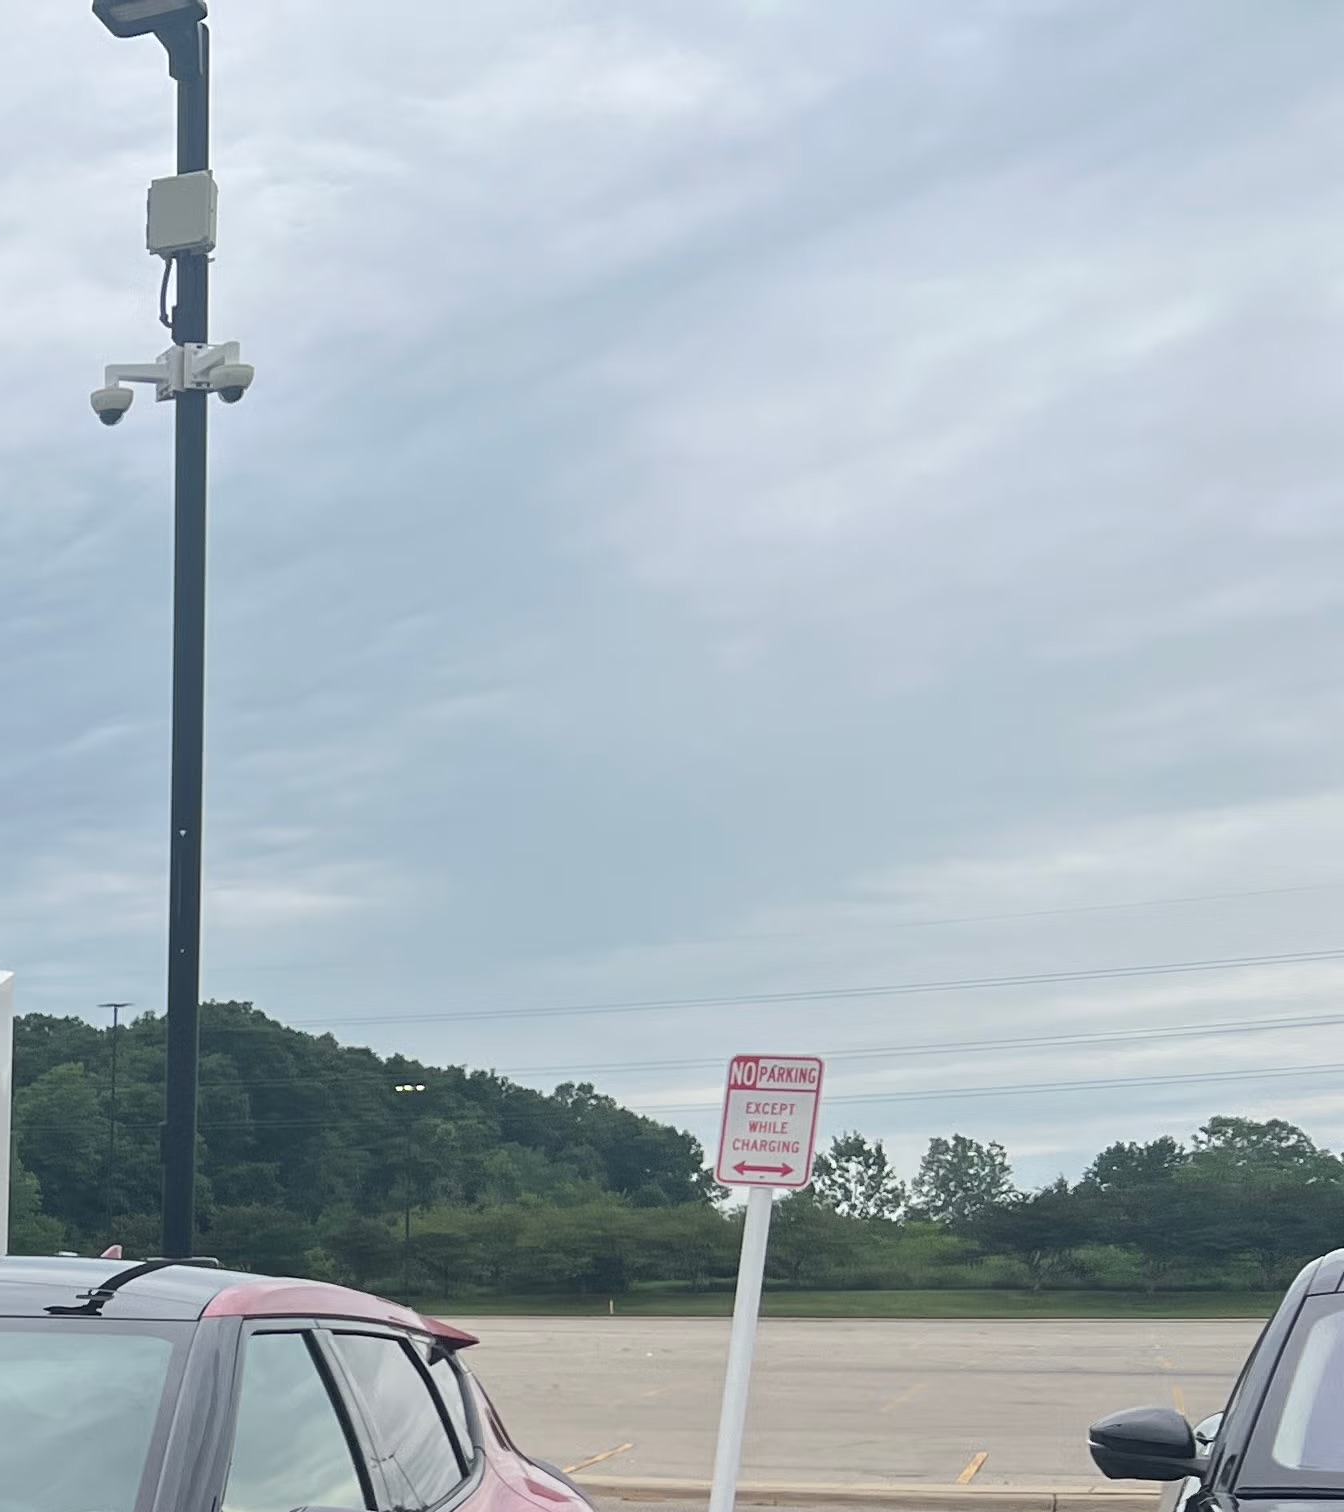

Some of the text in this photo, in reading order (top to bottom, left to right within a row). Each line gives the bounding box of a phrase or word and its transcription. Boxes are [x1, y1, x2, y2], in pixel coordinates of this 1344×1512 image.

[730, 1061, 817, 1086] NO PARKING
[745, 1101, 797, 1116] EXCEPT
[748, 1120, 789, 1135] WHILE
[732, 1139, 800, 1153] CHARGING
